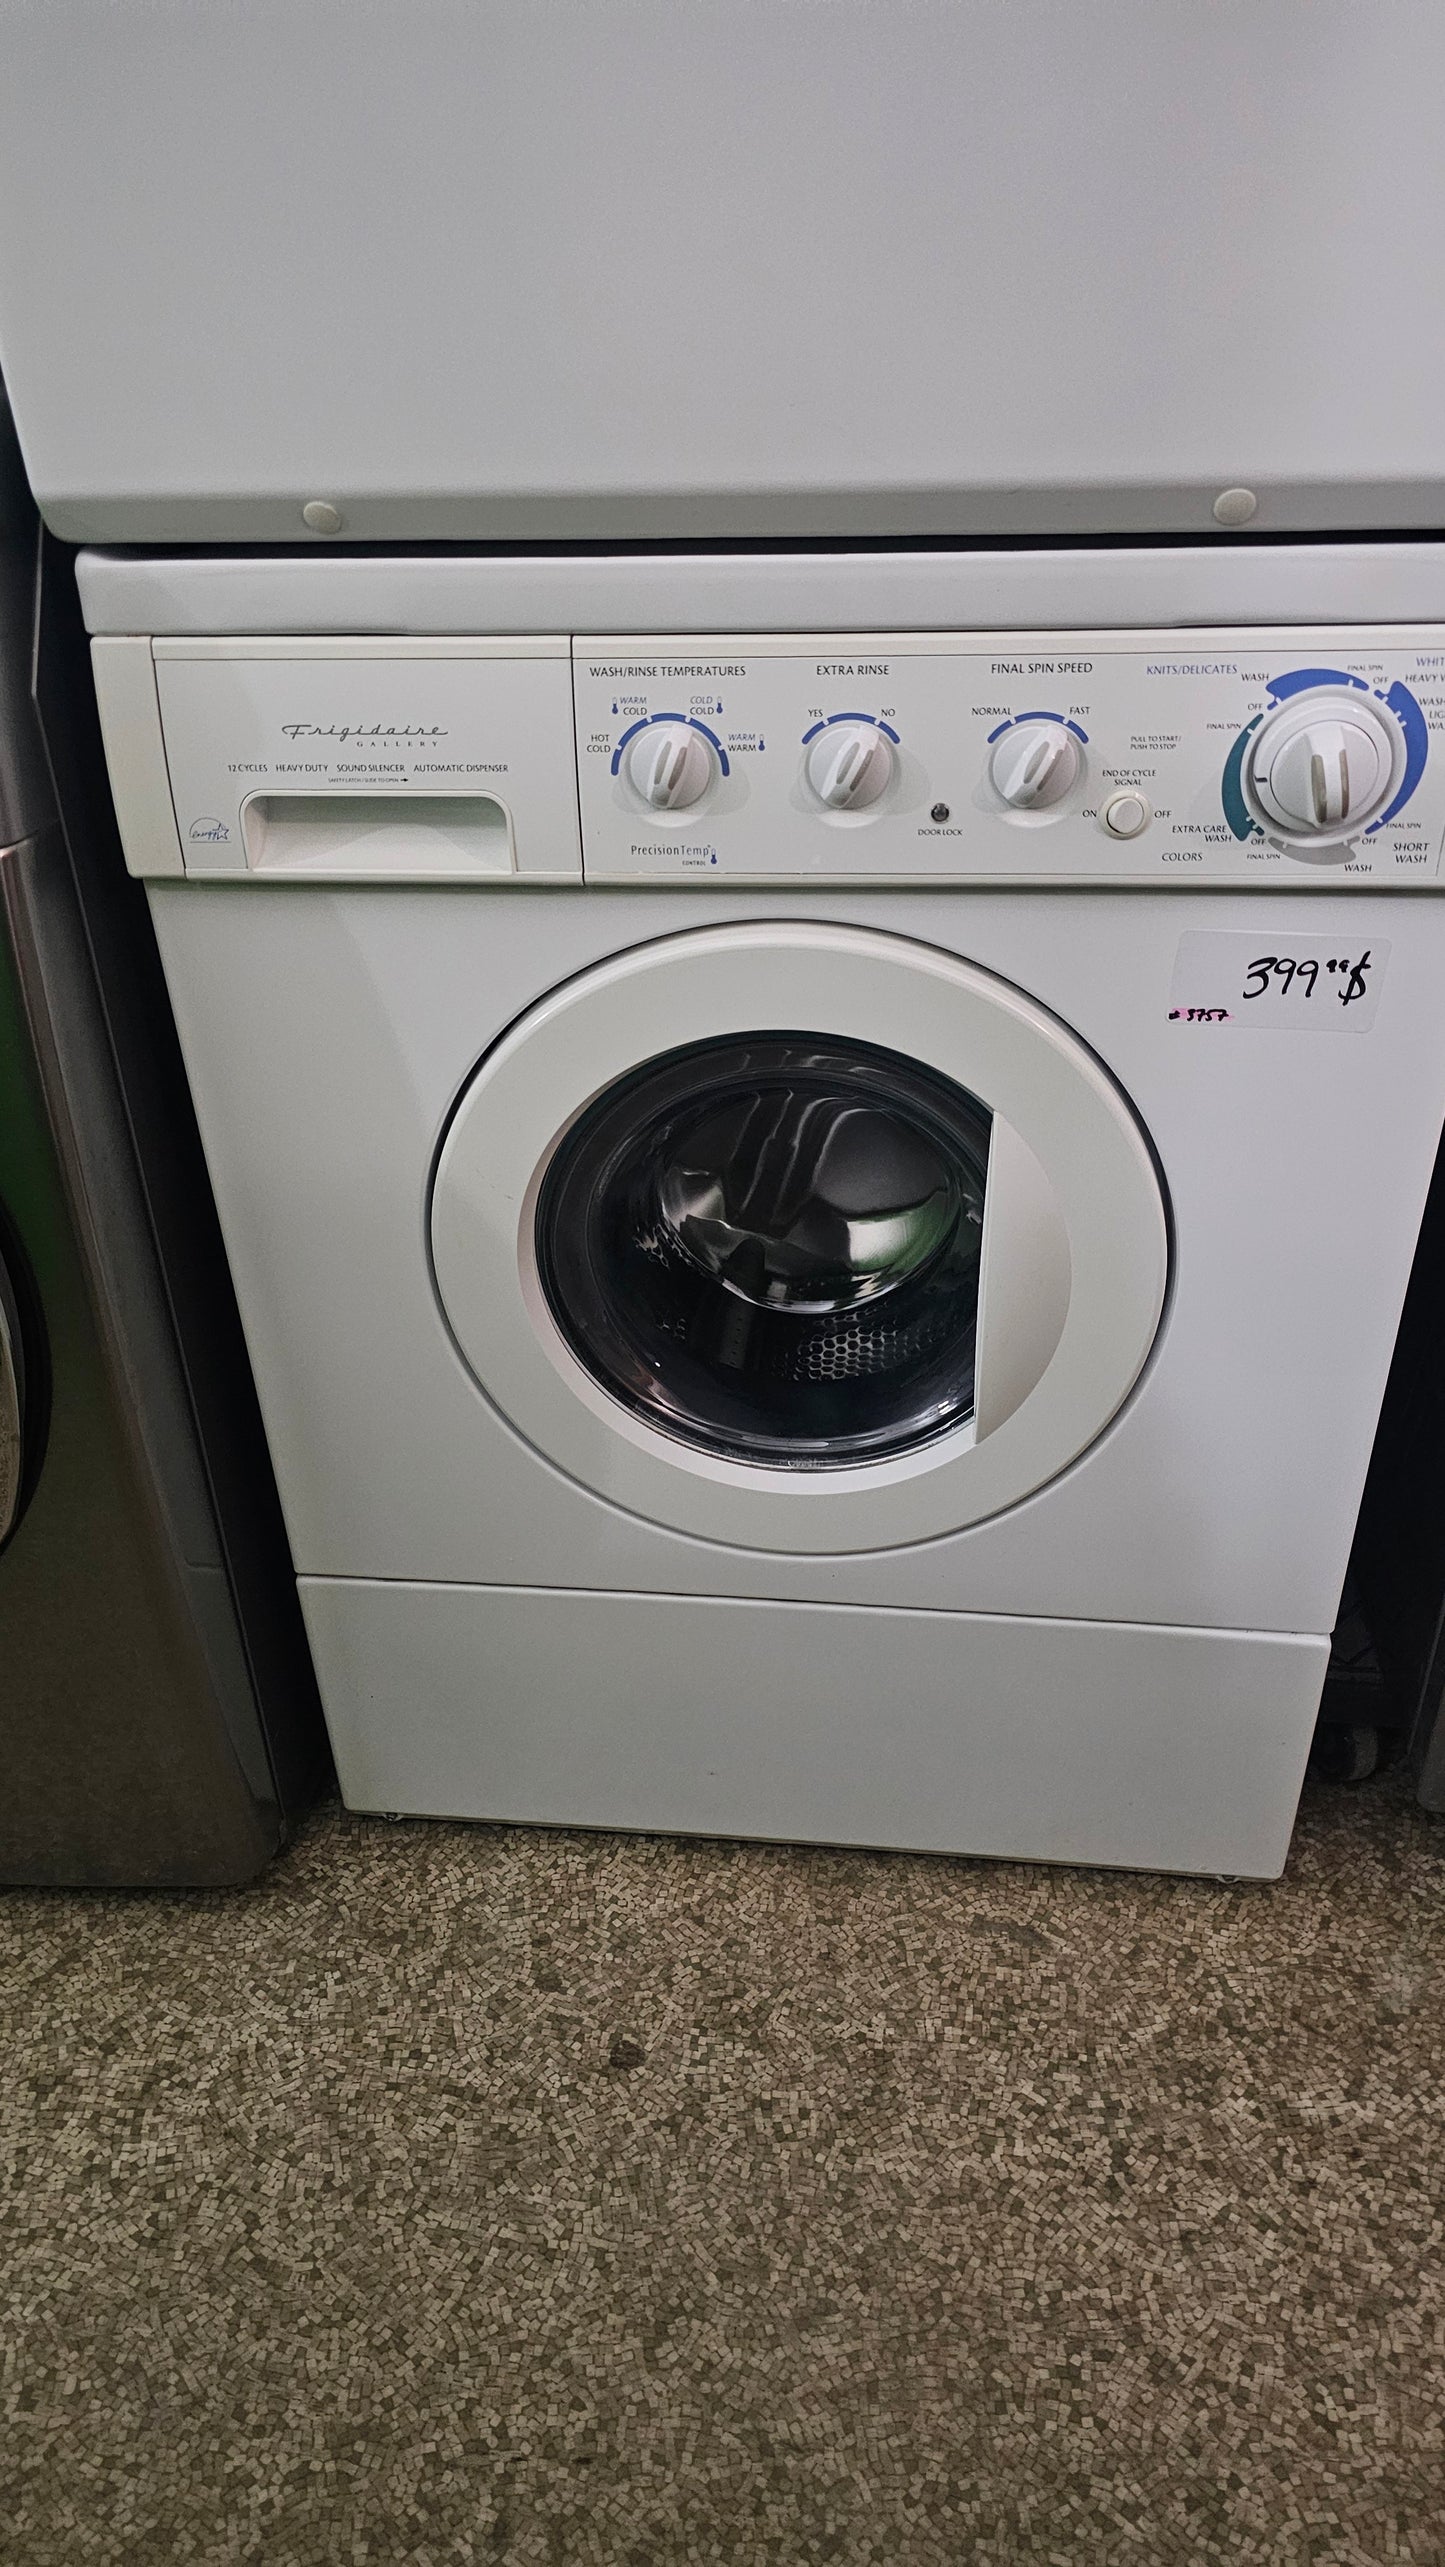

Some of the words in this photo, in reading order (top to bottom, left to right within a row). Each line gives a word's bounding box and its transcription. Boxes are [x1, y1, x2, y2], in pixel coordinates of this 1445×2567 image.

[589, 666, 658, 677] WASH/RINSE
[661, 665, 747, 677] TEMPERATURES
[816, 665, 858, 676] EXTRA
[859, 665, 890, 676] RINSE
[991, 663, 1025, 674] FINAL
[1028, 663, 1055, 674] SPIN
[1057, 663, 1093, 674] SPEED
[1146, 664, 1238, 675] KNITS/DELICATES
[1241, 673, 1269, 681] WASH
[1373, 676, 1389, 684] OFF
[1405, 674, 1438, 683] HEAVY
[690, 696, 713, 704] COLD
[623, 707, 647, 715] COLD
[690, 706, 714, 715] COLD
[1069, 707, 1091, 715] FAST
[1247, 703, 1263, 711] OFF
[808, 709, 824, 717] YES
[881, 709, 896, 717] NO
[971, 707, 1012, 716] NORMAL
[282, 724, 449, 742] Frigidaire
[590, 734, 610, 742] HOT
[586, 745, 611, 753] COLD
[727, 744, 757, 752] WARM
[228, 764, 237, 772] 12
[237, 764, 268, 772] CYCLES
[275, 764, 303, 772] HEAVY
[304, 764, 329, 772] DUTY
[336, 764, 368, 772] SOUND
[368, 764, 405, 772] SILENCER
[413, 764, 465, 772] AUTOMATIC
[466, 764, 509, 772] DISPENSER
[1102, 769, 1119, 777] END
[1119, 769, 1131, 777] OF
[1131, 769, 1157, 777] CYCLE
[1082, 809, 1098, 818] ON
[1154, 810, 1172, 819] OFF
[1172, 825, 1202, 833] EXTRA
[1203, 825, 1227, 833] CARE
[1204, 834, 1232, 842] WASH
[1393, 842, 1430, 851] SHORT
[1161, 852, 1203, 861] COLORS
[1395, 854, 1428, 863] WASH
[1343, 864, 1373, 872] WASH
